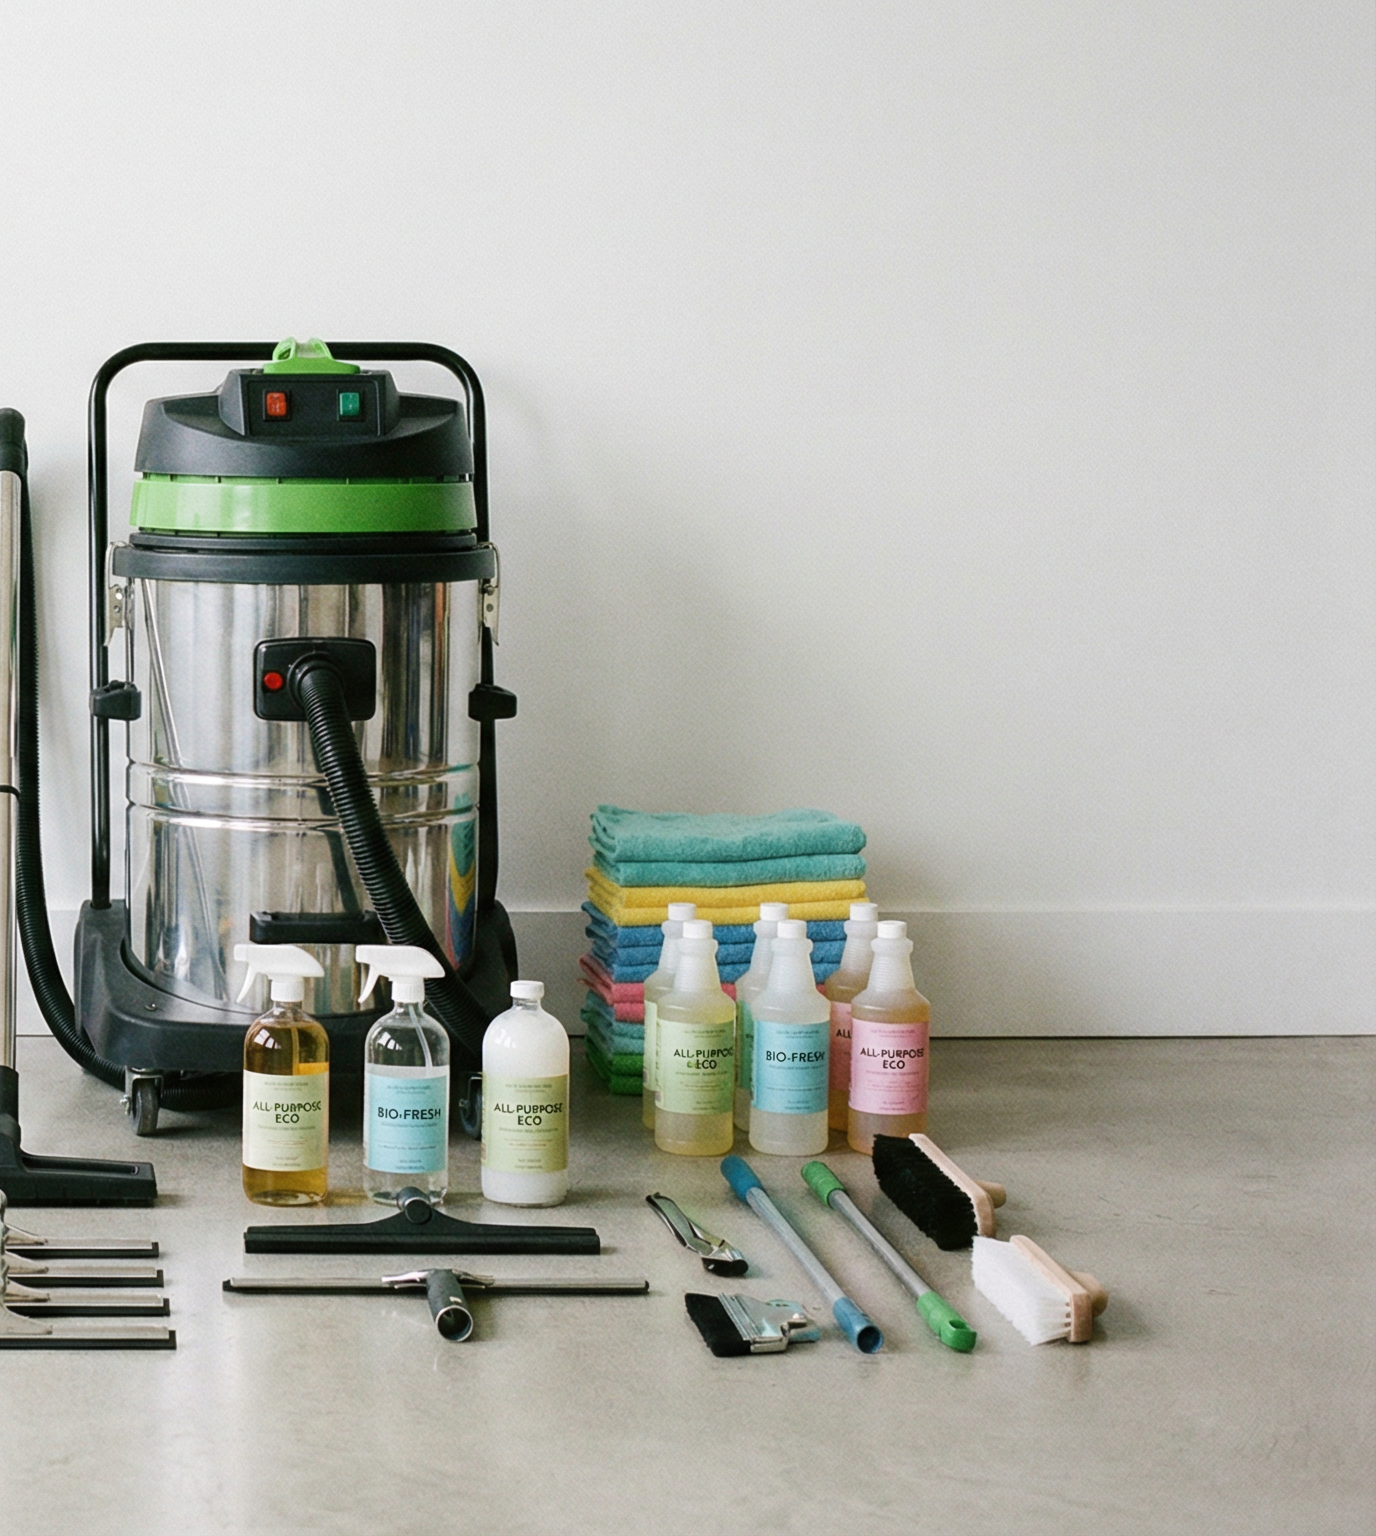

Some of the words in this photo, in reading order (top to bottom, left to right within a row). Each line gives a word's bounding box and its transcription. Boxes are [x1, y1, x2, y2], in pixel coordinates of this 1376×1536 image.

[882, 1060, 906, 1069] ECO
[275, 1113, 300, 1124] ECO
[517, 1115, 542, 1126] ECO
